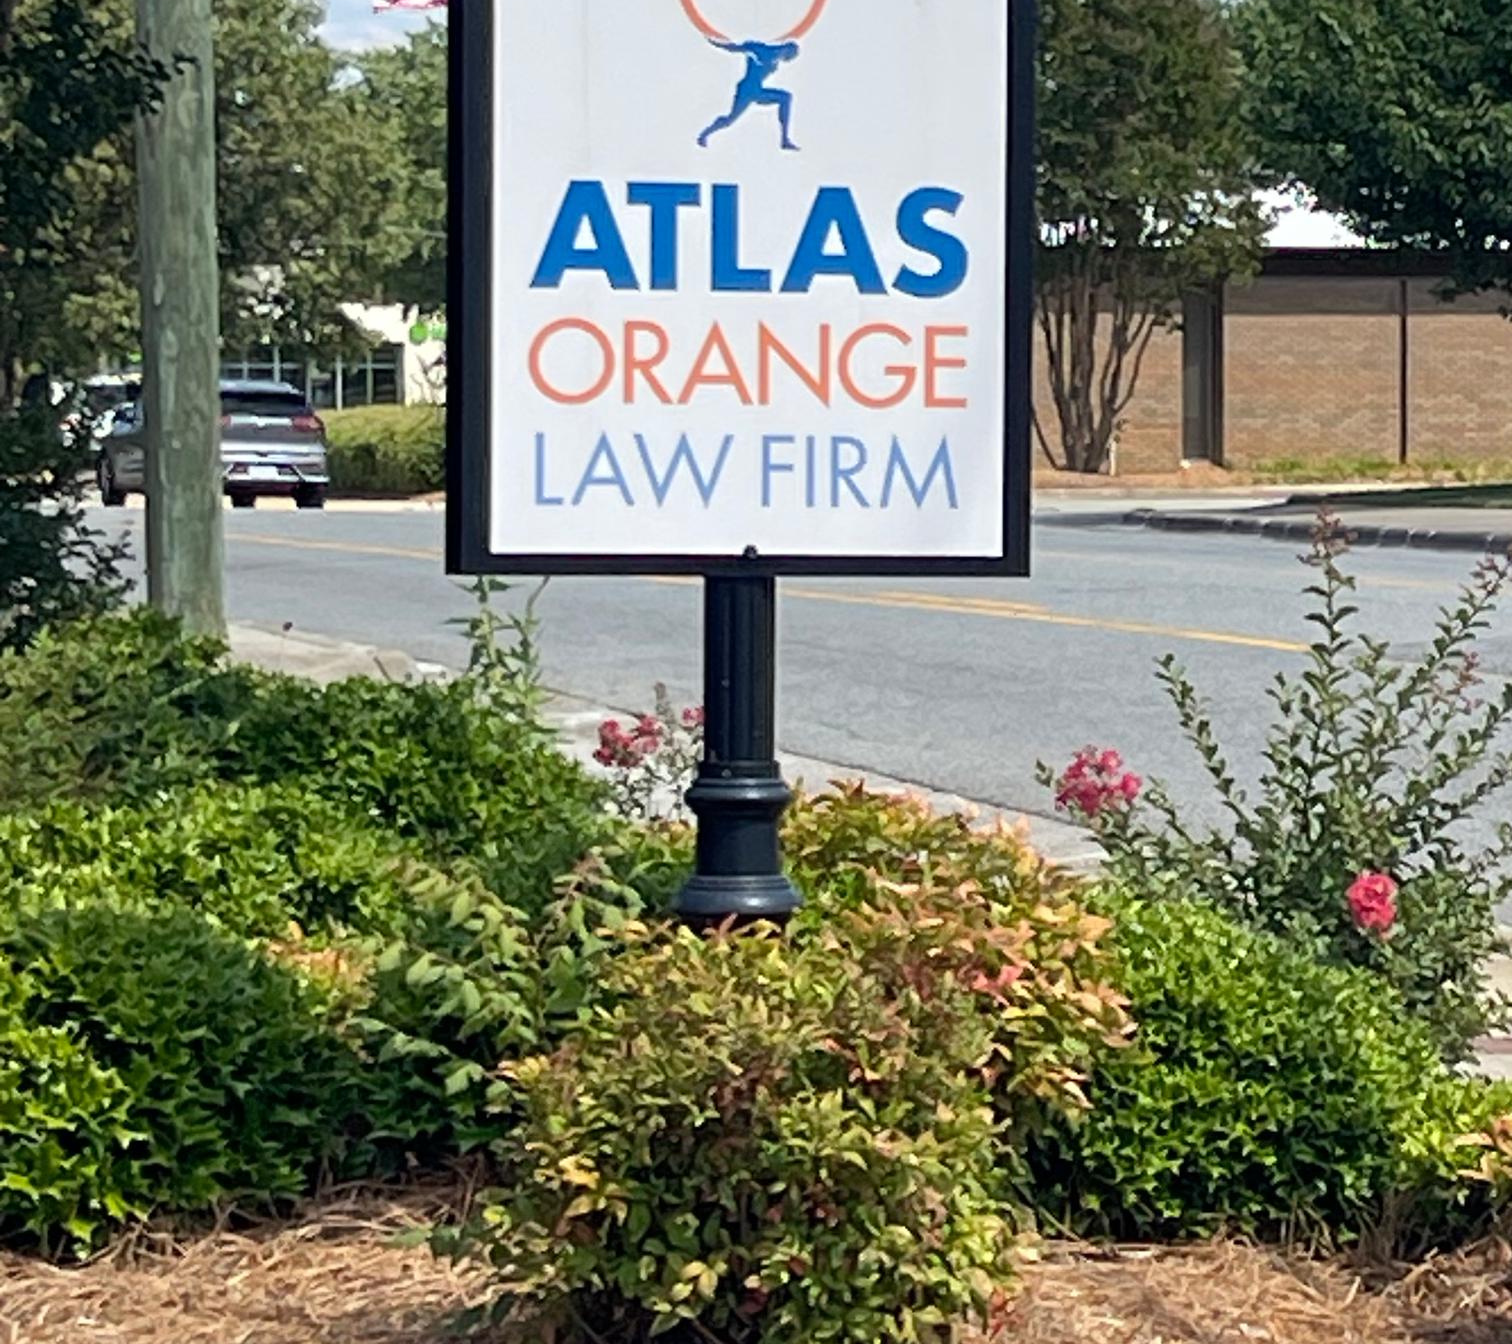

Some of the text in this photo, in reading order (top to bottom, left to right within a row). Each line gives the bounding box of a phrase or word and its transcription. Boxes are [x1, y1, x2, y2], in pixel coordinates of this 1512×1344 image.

[529, 179, 970, 299] ATLAS
[528, 316, 969, 409] ORANGE
[534, 432, 959, 510] LAW FIRM
